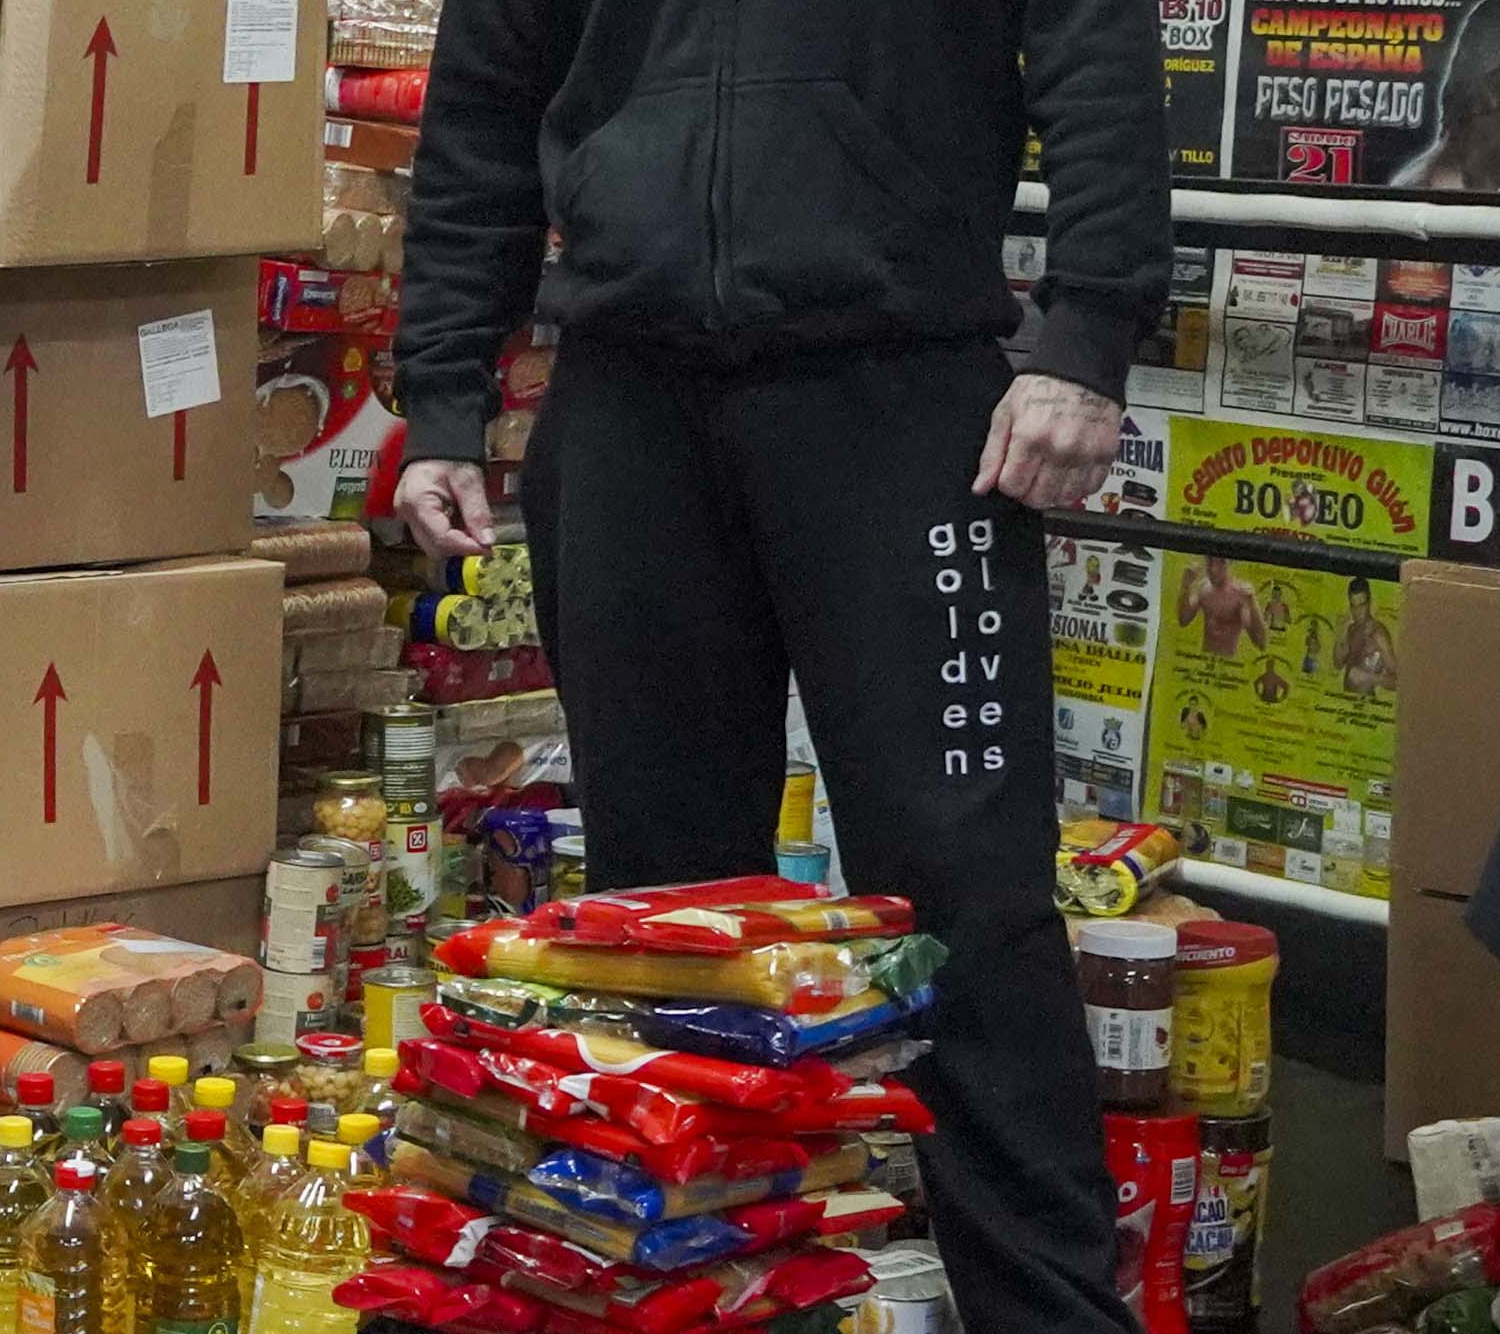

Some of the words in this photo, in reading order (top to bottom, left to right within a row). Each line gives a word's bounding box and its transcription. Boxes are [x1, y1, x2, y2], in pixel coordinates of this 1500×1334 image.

[1251, 11, 1444, 43] CAMPEONATO
[1266, 41, 1307, 68] DE
[1316, 38, 1423, 73] ESPAÑA
[1255, 74, 1316, 123] PESO
[1325, 78, 1424, 126] PESADO
[1286, 144, 1354, 183] 21
[1382, 310, 1437, 353] CHARLIE
